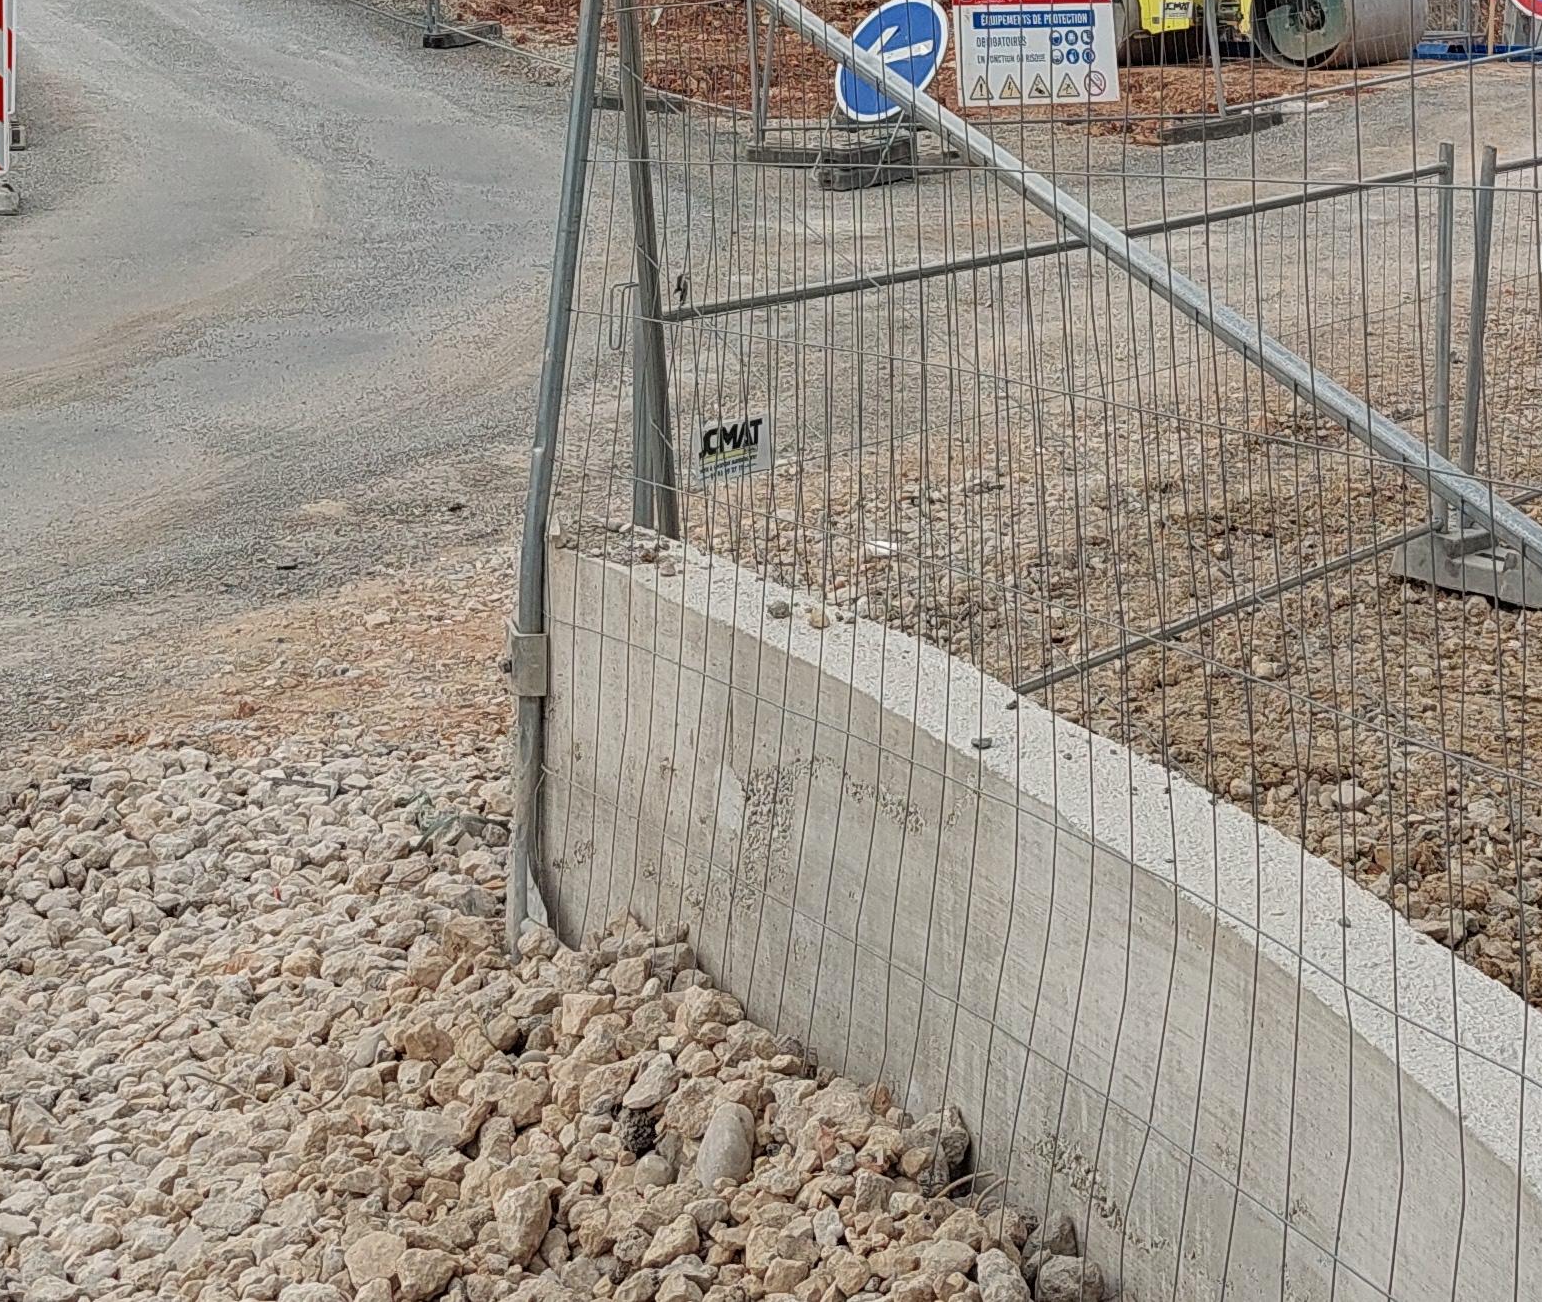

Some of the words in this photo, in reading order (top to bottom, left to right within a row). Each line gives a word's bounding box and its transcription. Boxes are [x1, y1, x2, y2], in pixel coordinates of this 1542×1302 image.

[981, 14, 1031, 26] ÉUIPEMETS
[1032, 15, 1042, 25] DE
[976, 36, 1027, 48] OBIGATOIRS
[988, 54, 1014, 64] ONCTION
